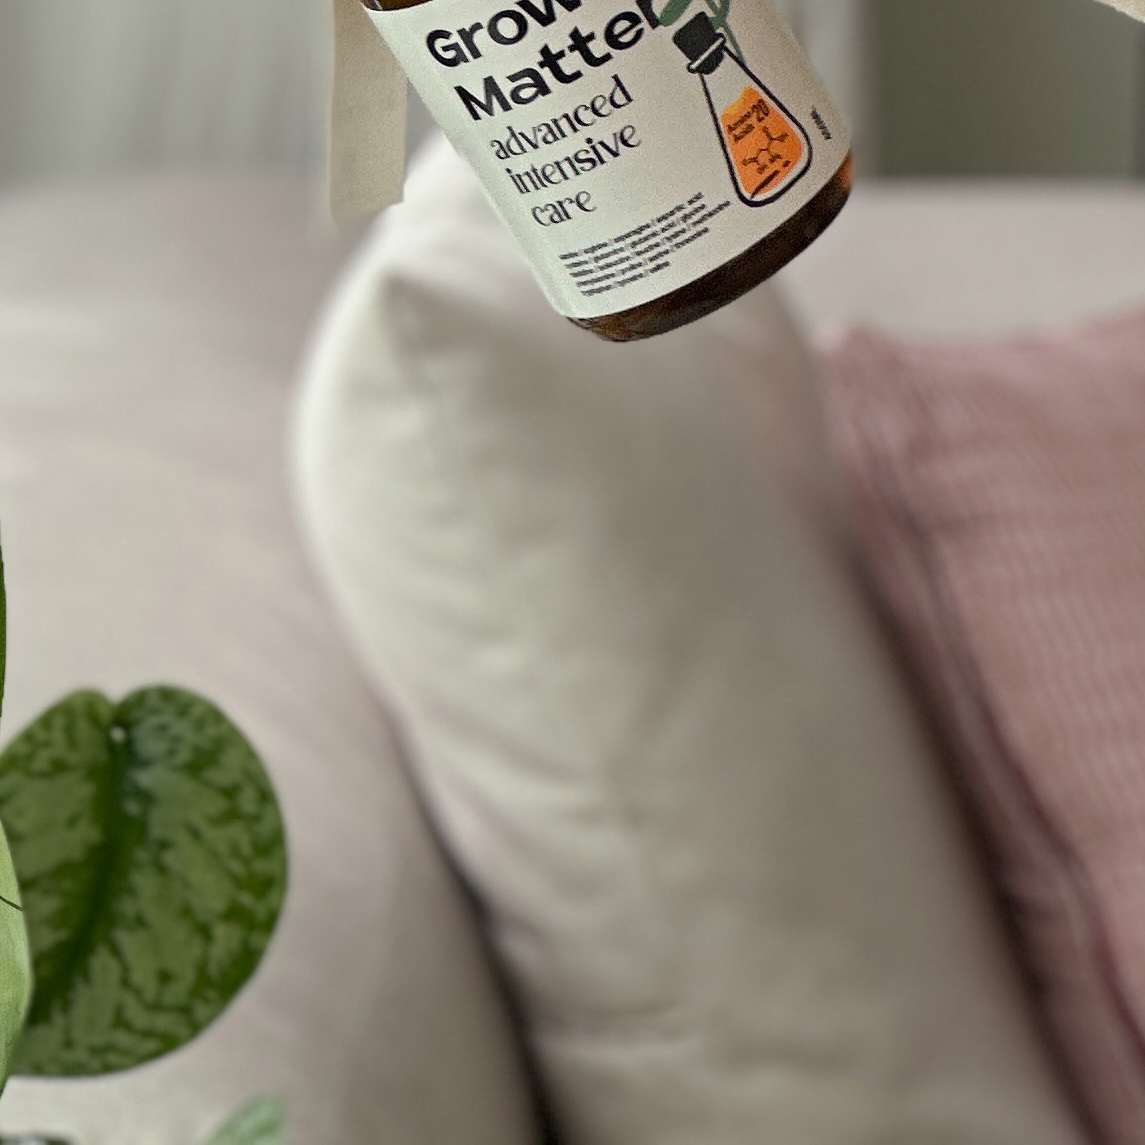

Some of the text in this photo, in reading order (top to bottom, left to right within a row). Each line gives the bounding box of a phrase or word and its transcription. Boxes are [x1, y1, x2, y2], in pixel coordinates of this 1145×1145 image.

[489, 73, 635, 160] advanced
[505, 123, 642, 195] intensive
[531, 190, 598, 227] care
